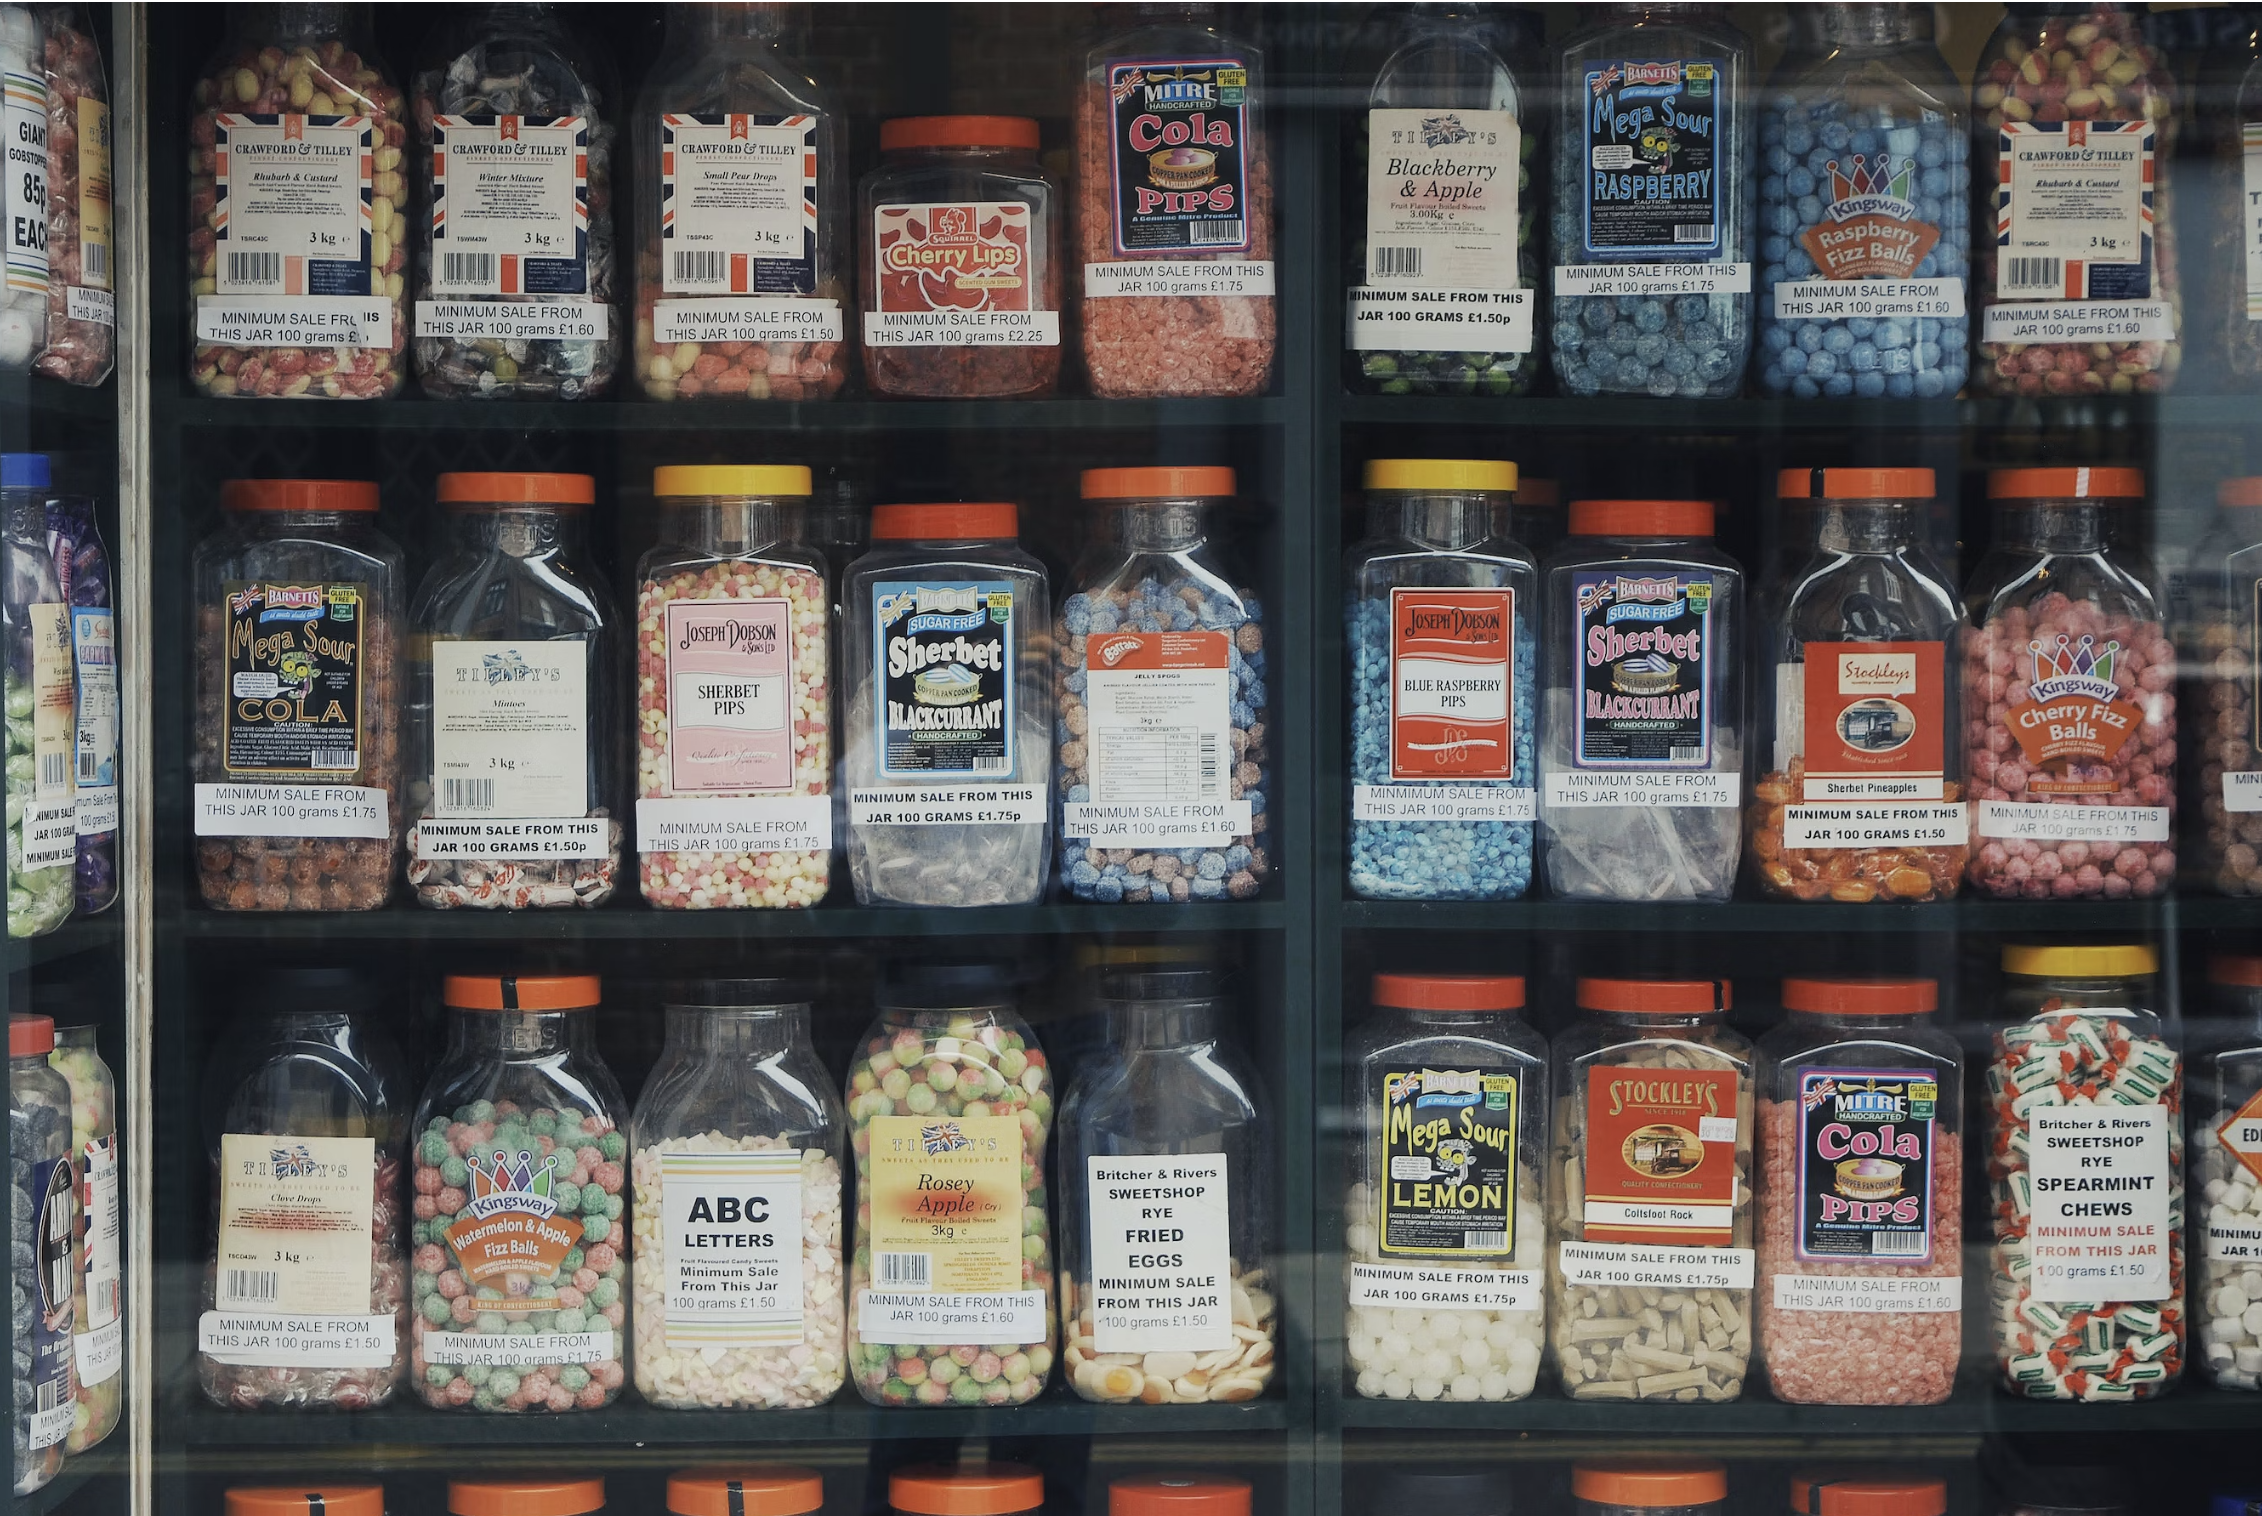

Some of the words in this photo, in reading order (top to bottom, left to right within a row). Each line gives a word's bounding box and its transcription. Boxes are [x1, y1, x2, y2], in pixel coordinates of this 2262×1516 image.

[1628, 66, 1677, 81] BARNETTS
[1144, 82, 1217, 103] MITRE
[1149, 101, 1211, 110] HANDCRAFTED
[1593, 97, 1653, 144] Mega
[1660, 97, 1713, 138] Sour
[1129, 113, 1233, 152] Cola
[235, 143, 296, 155] CRAWFORD
[313, 144, 353, 156] TILLEY
[703, 170, 728, 181] Small
[730, 171, 749, 181] Pear
[752, 171, 777, 183] Drops
[1386, 158, 1497, 181] Blackberry
[253, 172, 291, 183] Rhubarb
[292, 173, 300, 183] &
[302, 172, 338, 183] Custard
[479, 172, 508, 183] Winter
[510, 172, 544, 183] Mixture
[1594, 168, 1712, 200] RASPBERRY
[23, 172, 46, 214] 85p
[1400, 182, 1419, 198] &
[1424, 181, 1483, 201] Apple
[1135, 184, 1234, 214] PIPS
[1832, 197, 1913, 220] Kingsway
[310, 232, 317, 244] 3
[319, 232, 336, 247] kg
[931, 233, 975, 243] SQUIRREL
[1819, 220, 1920, 249] Raspberry
[892, 245, 967, 270] Cherry
[972, 246, 1016, 267] Lips
[1825, 245, 1866, 267] Fizz
[1869, 242, 1915, 264] Balls
[1349, 290, 1405, 302] MINIMUM
[1409, 292, 1446, 303] SALE
[1450, 293, 1490, 304] FROM
[1492, 293, 1523, 304] THIS
[1793, 286, 1857, 298] MINIMUM
[1862, 285, 1896, 298] SALE
[1900, 284, 1939, 297] FROM
[1782, 302, 1814, 315] THIS
[1818, 302, 1845, 315] JAR
[1849, 302, 1871, 314] 100
[1874, 304, 1914, 316] grams
[1916, 301, 1949, 314] £1.60
[1357, 310, 1384, 322] JAR
[1388, 311, 1410, 322] 100
[1415, 311, 1464, 323] GRAMS
[1467, 313, 1511, 326] £1.50p
[268, 589, 320, 607] BARNETTS
[910, 615, 950, 631] SUGAR
[952, 612, 984, 628] FREE
[1405, 609, 1450, 637] JOSEPH
[1450, 607, 1500, 637] DOBSON
[680, 621, 726, 650] JOSEPH
[726, 619, 777, 648] DOBSON
[232, 618, 295, 671] Mega
[303, 620, 356, 661] Sour
[1586, 624, 1700, 667] Sherbet
[888, 636, 1002, 679] Sherbet
[697, 684, 761, 699] SHERBET
[1404, 680, 1434, 692] BLUE
[1436, 679, 1501, 692] RASPBERRY
[2037, 679, 2116, 701] Kingsway
[492, 699, 526, 708] Mintoes
[713, 700, 746, 716] PIPS
[1440, 695, 1466, 708] PIPS
[1586, 688, 1699, 720] BLACKCURRANT
[237, 699, 348, 723] COLA
[888, 699, 1002, 731] BLACKCURRANT
[2020, 705, 2087, 730] Cherry
[2089, 704, 2129, 730] Fizz
[917, 731, 978, 740] HANDCRAFTED
[2049, 721, 2098, 741] Balls
[488, 757, 496, 770] 3
[499, 757, 516, 772] kg
[1827, 782, 1865, 794] Sherbet
[1867, 782, 1917, 795] Pineapples
[34, 829, 49, 841] JAR
[51, 828, 62, 839] 100
[432, 841, 458, 853] JAR
[462, 841, 486, 853] 100
[490, 841, 539, 853] GRAMS
[543, 840, 587, 855] £1.50p
[1609, 1080, 1719, 1116] STOCKLEY'S
[1390, 1107, 1452, 1156] Mega
[1459, 1106, 1509, 1153] Sour
[2039, 1119, 2092, 1129] Britcher
[2097, 1119, 2107, 1129] &
[2112, 1119, 2151, 1128] Rivers
[1817, 1123, 1921, 1161] Cola
[2047, 1136, 2144, 1148] SWEETSHOP
[2081, 1157, 2112, 1167] RYE
[1096, 1170, 1152, 1180] Britcher
[1157, 1169, 1167, 1179] &
[1173, 1168, 1217, 1178] Rivers
[916, 1174, 974, 1195] Rosey
[2037, 1175, 2155, 1191] SPEARMINT
[270, 1193, 295, 1204] Clove
[297, 1194, 322, 1205] Drops
[1108, 1187, 1205, 1200] SWEETSHOP
[1392, 1183, 1502, 1210] LEMON
[474, 1195, 552, 1216] Kingsway
[688, 1196, 770, 1224] ABC
[916, 1195, 975, 1217] Apple
[1819, 1193, 1920, 1223] PIPS
[2060, 1202, 2133, 1217] CHEWS
[1142, 1208, 1173, 1219] RYE
[1624, 1208, 1666, 1220] Coltsfoot
[1670, 1208, 1694, 1220] Rock
[452, 1218, 521, 1250] Watermelon
[526, 1219, 535, 1231] &
[537, 1222, 571, 1247] Apple
[931, 1224, 954, 1239] 3kg
[1125, 1228, 1184, 1243] FRIED
[2037, 1226, 2111, 1237] MINIMUM
[2117, 1225, 2154, 1236] SALE
[684, 1233, 774, 1248] LETTERS
[483, 1242, 507, 1257] Fizz
[510, 1241, 539, 1257] Balls
[2036, 1246, 2080, 1257] FROM
[2086, 1245, 2122, 1256] THIS
[2128, 1244, 2157, 1255] JAR
[1128, 1254, 1183, 1268] EGGS
[680, 1266, 744, 1278] Minimum
[748, 1266, 779, 1278] Sale
[1354, 1268, 1414, 1282] MINIMUM
[1418, 1271, 1452, 1283] SALE
[1456, 1273, 1496, 1284] FROM
[1498, 1274, 1529, 1285] THIS
[681, 1281, 719, 1292] From
[722, 1281, 751, 1292] This
[755, 1281, 779, 1291] Jar
[1098, 1278, 1170, 1289] MINIMUM
[1176, 1276, 1215, 1288] SALE
[672, 1297, 695, 1309] 100
[698, 1299, 737, 1311] grams
[740, 1296, 776, 1309] £1.50
[1097, 1297, 1140, 1309] FROM
[1145, 1297, 1182, 1308] THIS
[1187, 1296, 1218, 1307] JAR
[1363, 1290, 1390, 1301] JAR
[1394, 1291, 1417, 1302] 100
[1421, 1292, 1470, 1304] GRAMS
[1474, 1293, 1516, 1306] £1.75p
[1105, 1317, 1127, 1328] 100
[1130, 1318, 1168, 1330] grams
[1172, 1315, 1208, 1327] £1.50
